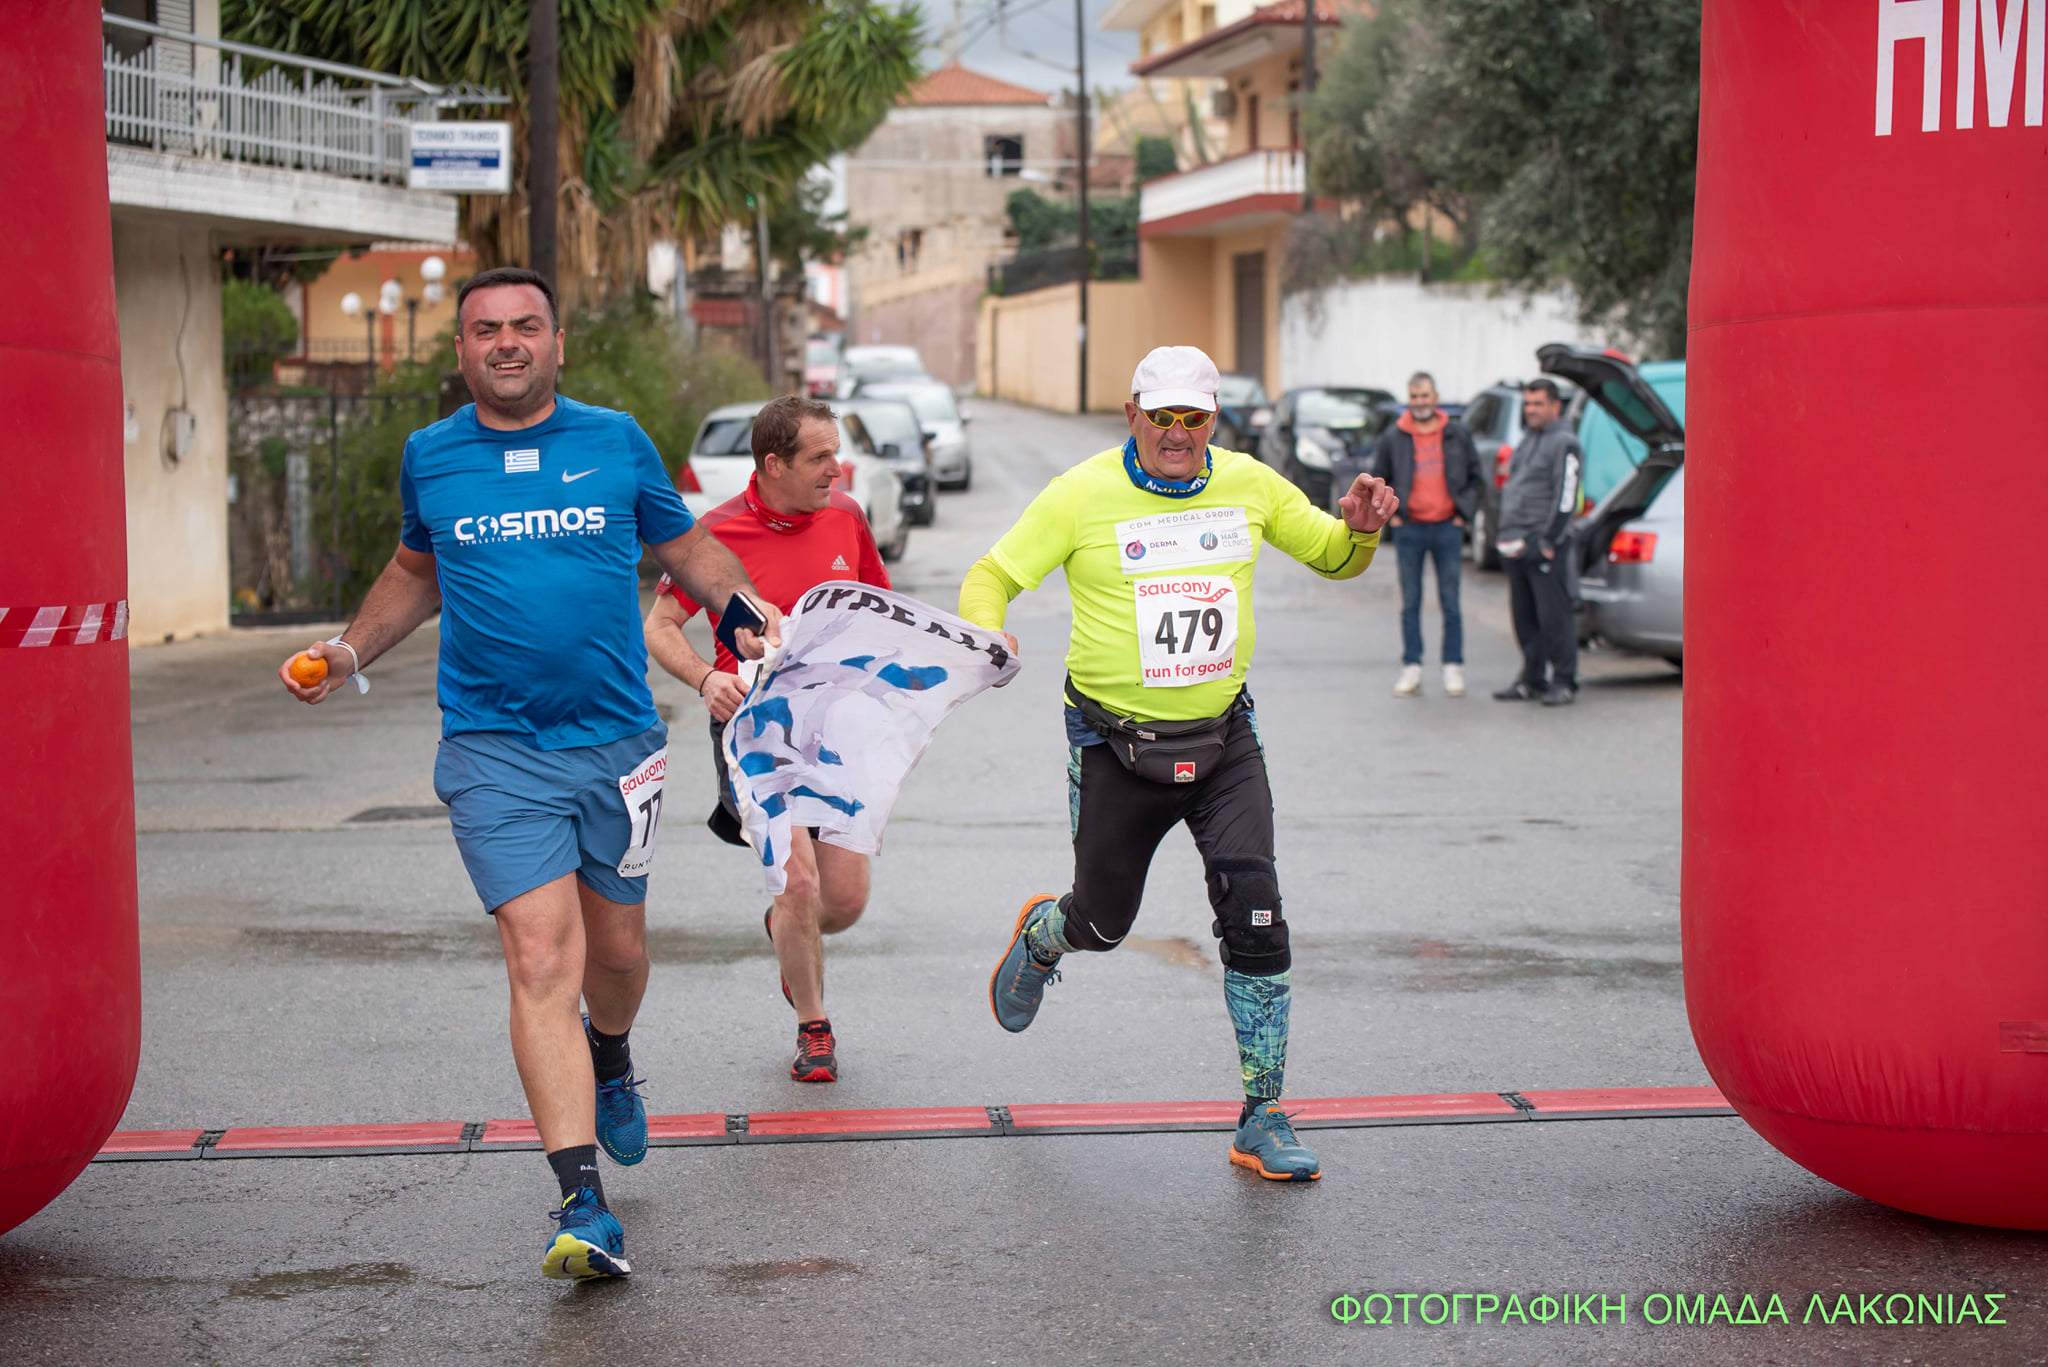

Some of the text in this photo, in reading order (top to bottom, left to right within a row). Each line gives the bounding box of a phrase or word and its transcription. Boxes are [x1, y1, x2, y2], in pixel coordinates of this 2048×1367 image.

[1158, 513, 1201, 525] MEDICAL
[1204, 510, 1234, 519] GROUP
[460, 535, 508, 546] ATHLETIC
[529, 530, 570, 540] CASUAL
[578, 528, 603, 536] WEAR
[1149, 540, 1178, 549] DERMA
[1138, 581, 1212, 597] saucony
[1155, 607, 1223, 655] 479
[1145, 657, 1233, 678] run for good
[622, 754, 668, 796] saucony
